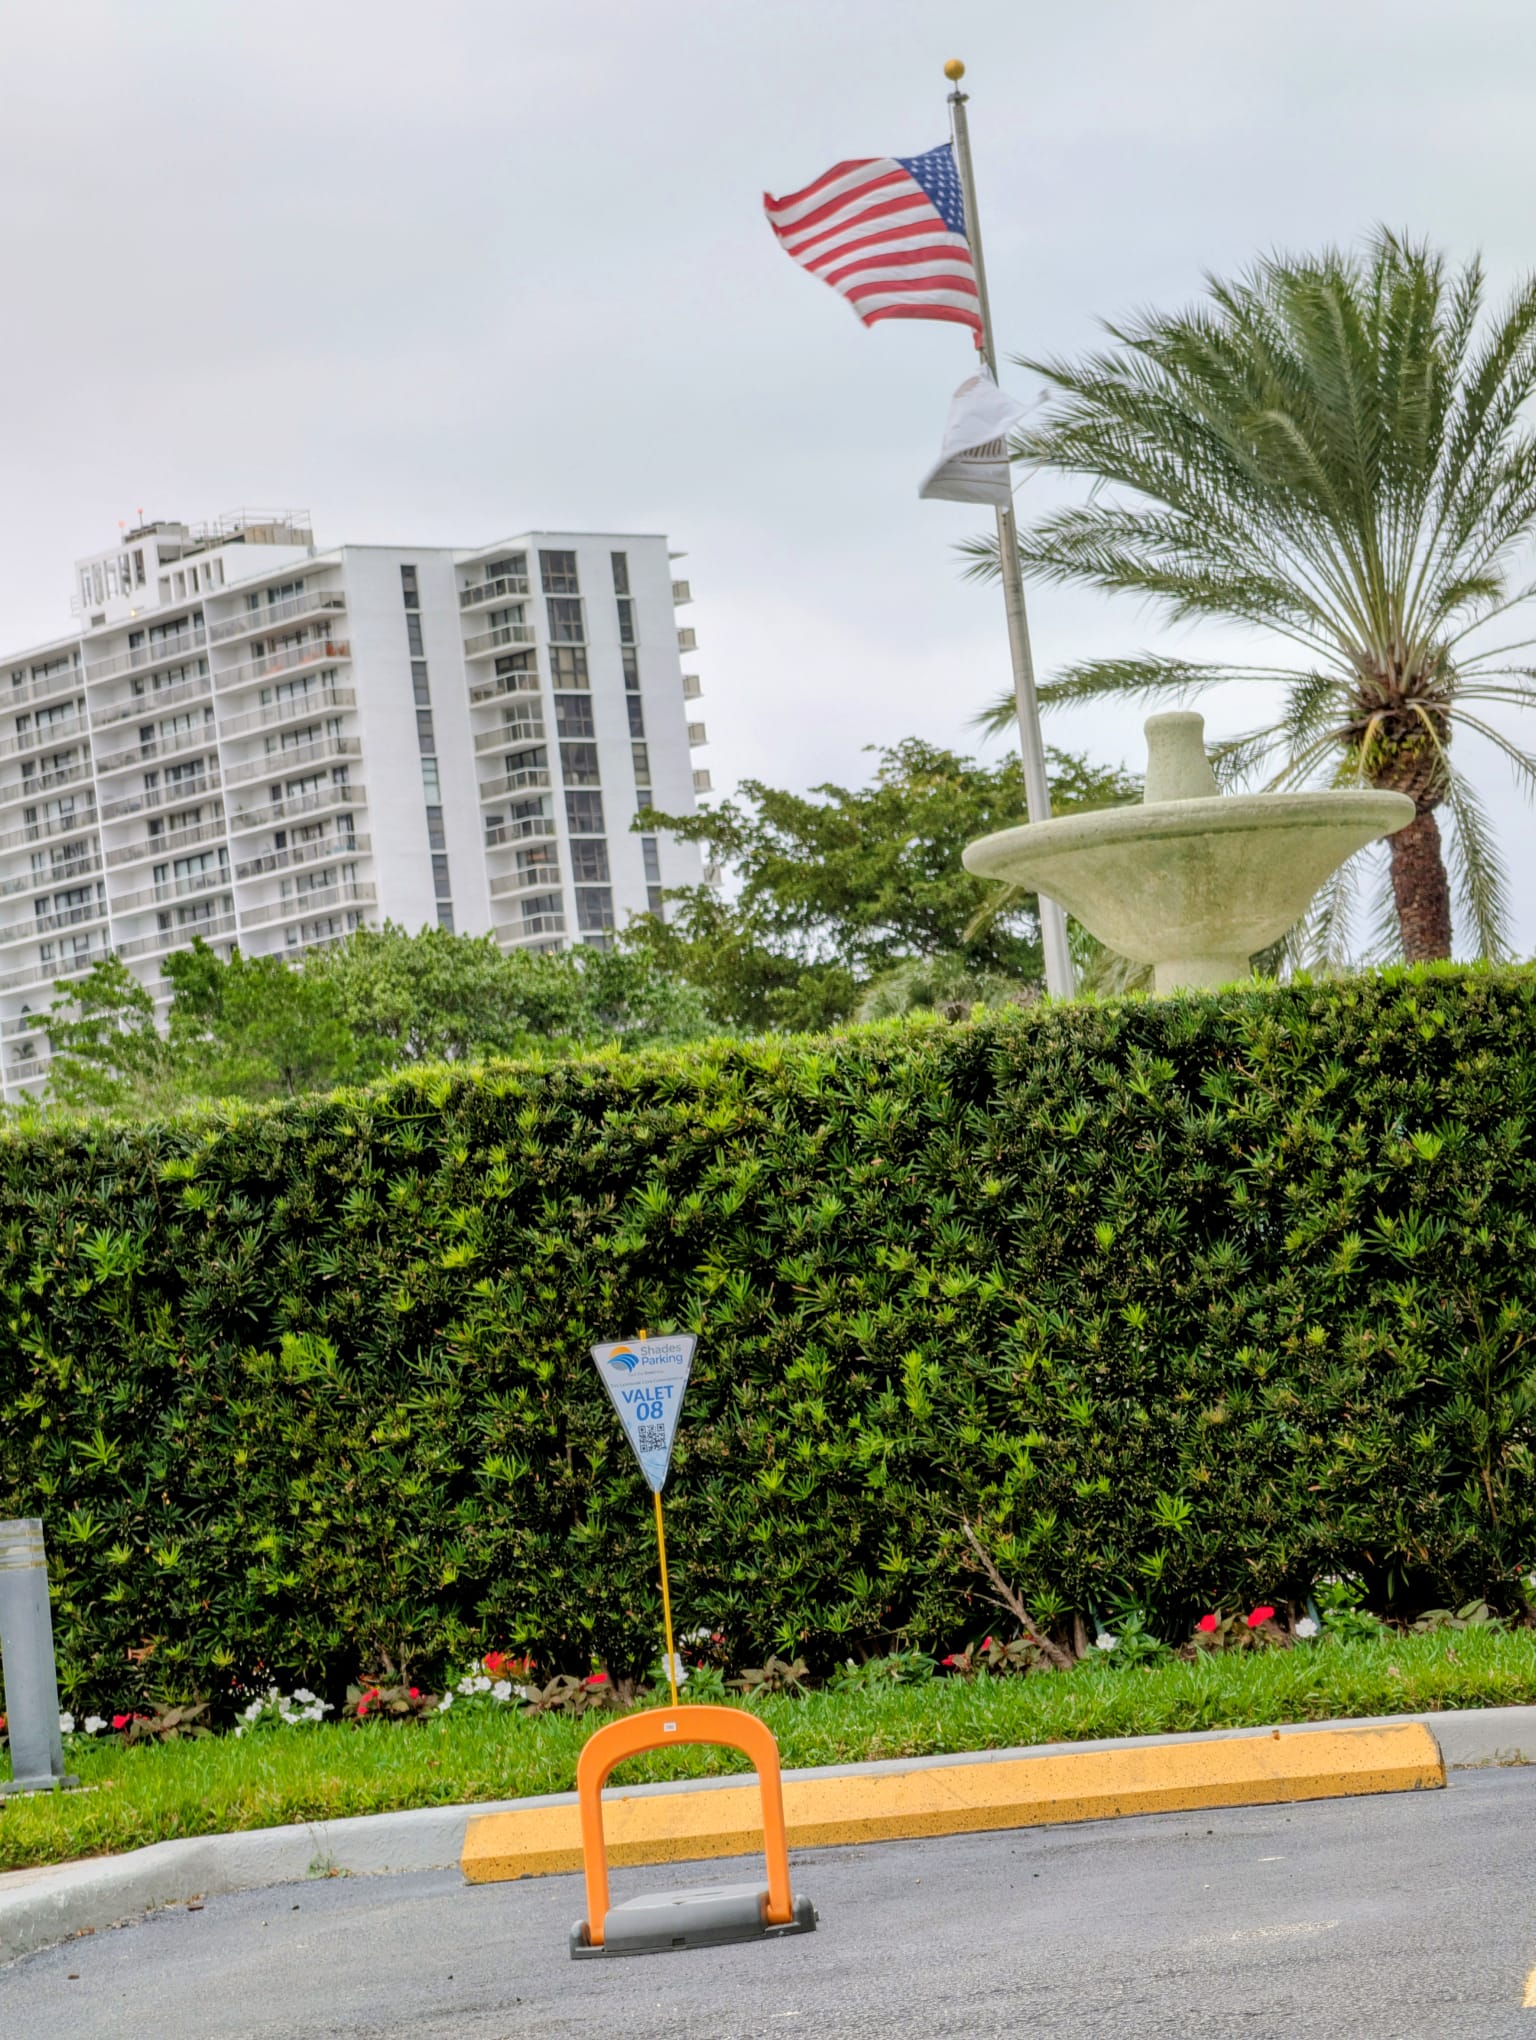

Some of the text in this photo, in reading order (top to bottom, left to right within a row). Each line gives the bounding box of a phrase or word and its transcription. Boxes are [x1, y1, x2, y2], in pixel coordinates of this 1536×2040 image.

[640, 1343, 681, 1355] Shades
[641, 1353, 683, 1366] Parking
[621, 1385, 674, 1403] VALET
[636, 1401, 664, 1421] 08
